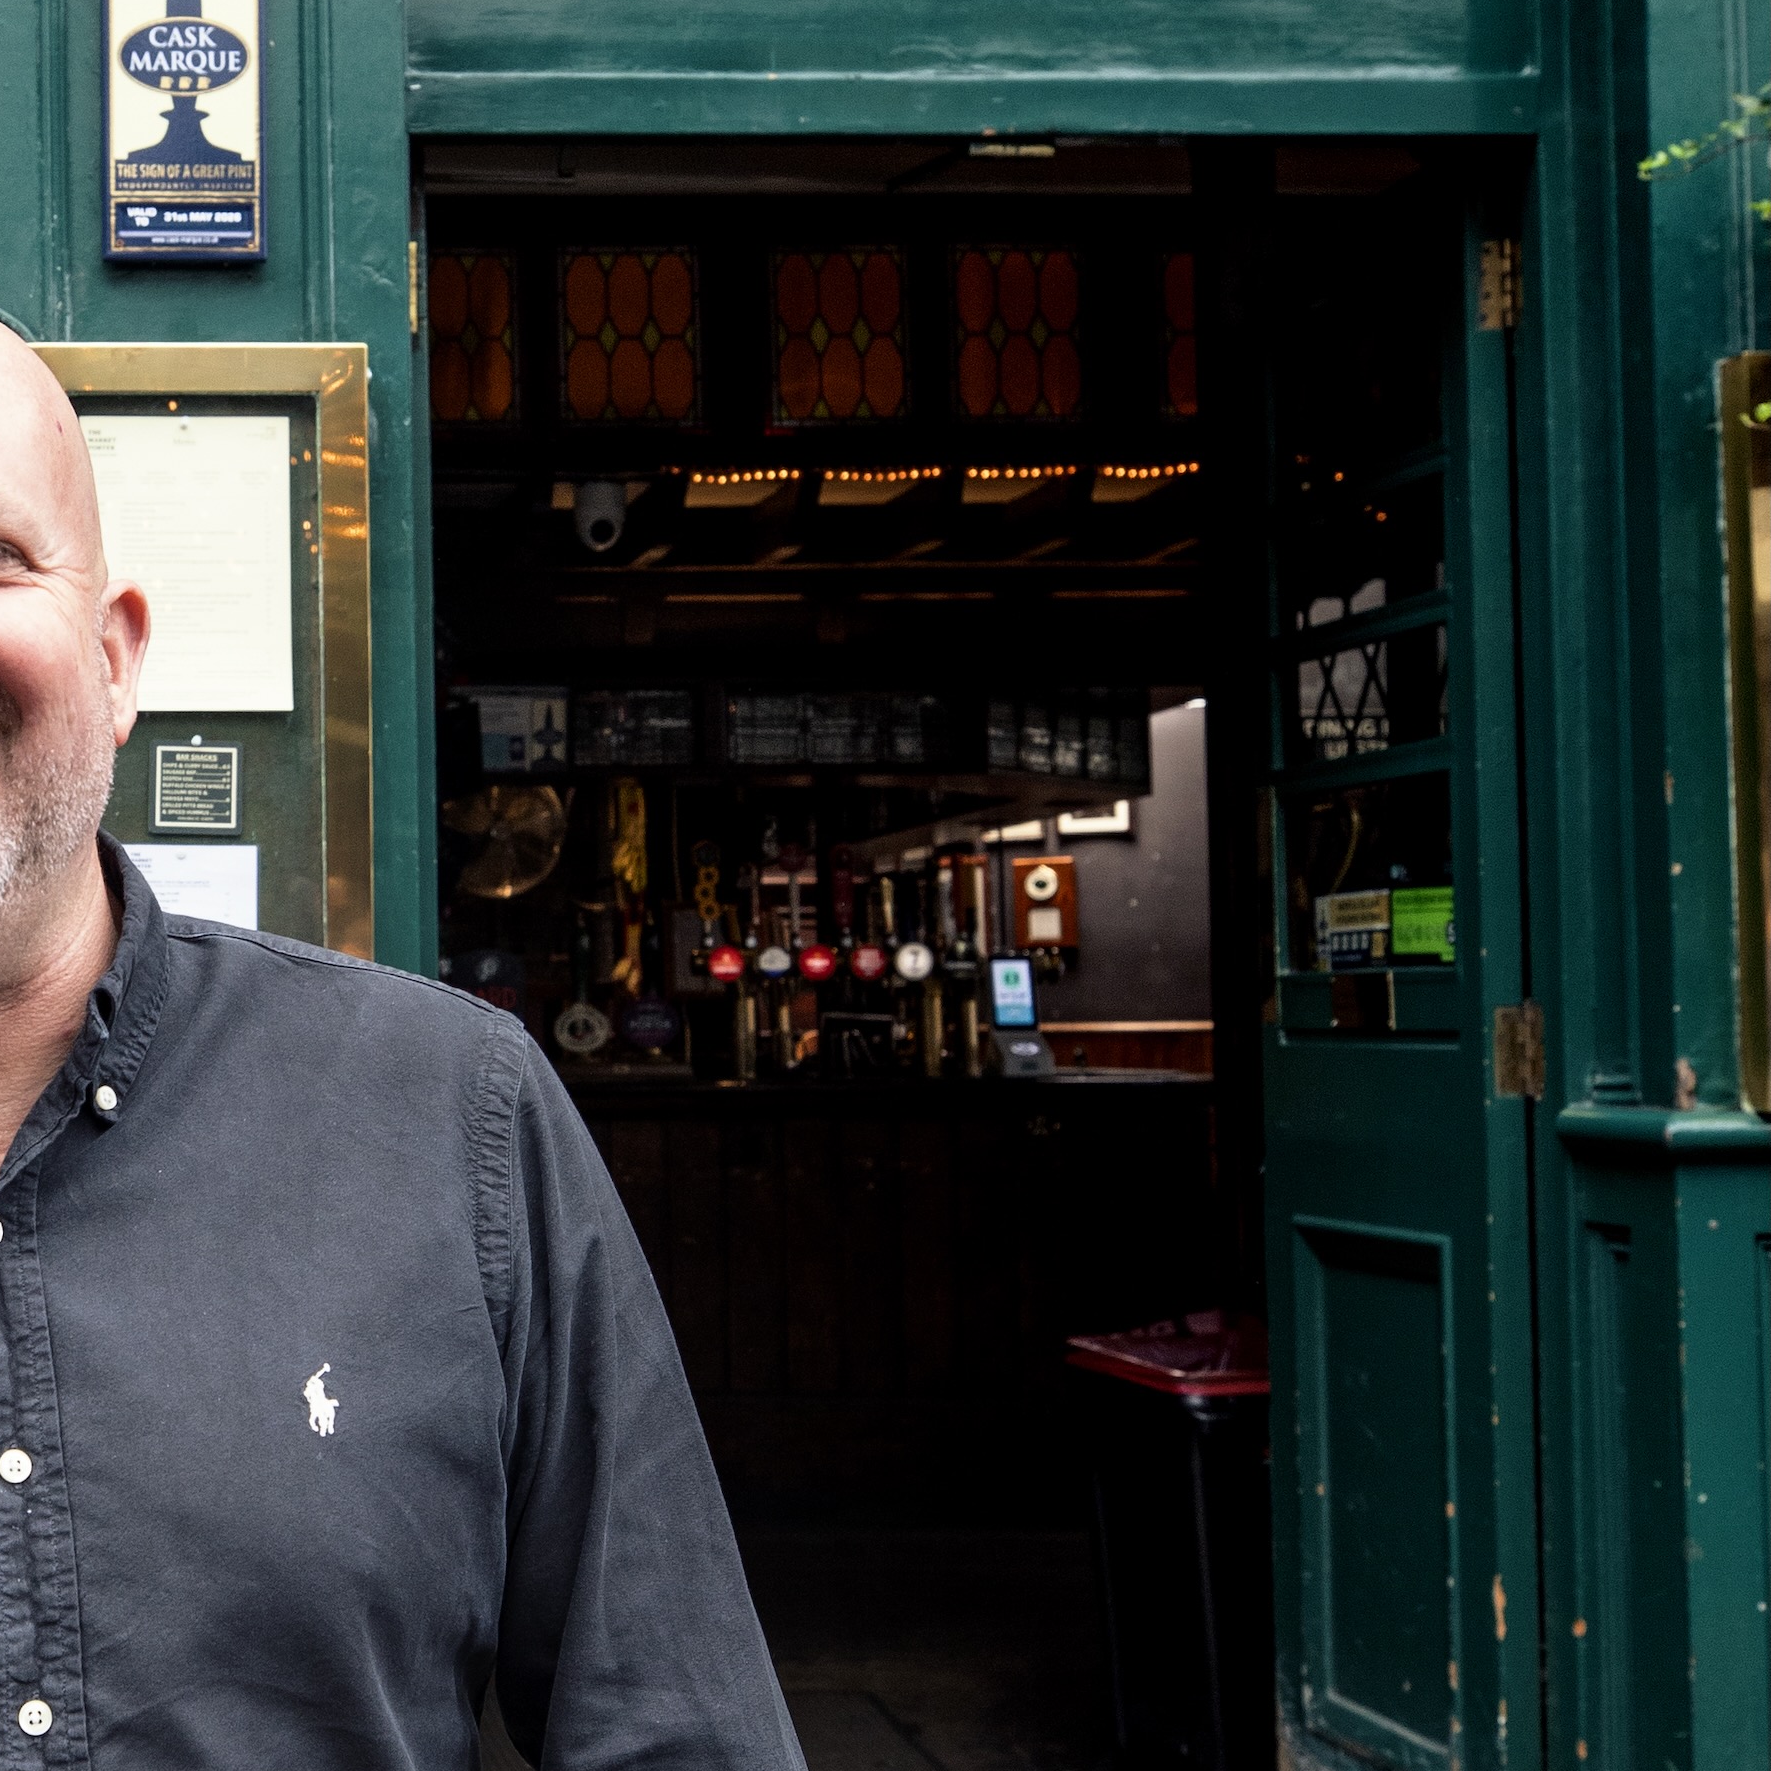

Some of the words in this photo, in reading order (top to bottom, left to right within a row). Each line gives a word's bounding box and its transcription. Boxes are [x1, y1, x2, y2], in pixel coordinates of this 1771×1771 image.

[148, 26, 217, 49] CASK
[129, 49, 242, 75] MARQUE
[117, 164, 138, 178] THE
[139, 164, 165, 178] SIGN
[167, 164, 181, 179] OF
[183, 165, 192, 178] A
[192, 164, 226, 178] GREAT
[228, 165, 253, 178] PINT
[127, 207, 157, 217] VALID
[189, 212, 213, 222] MAY
[135, 217, 150, 226] TO
